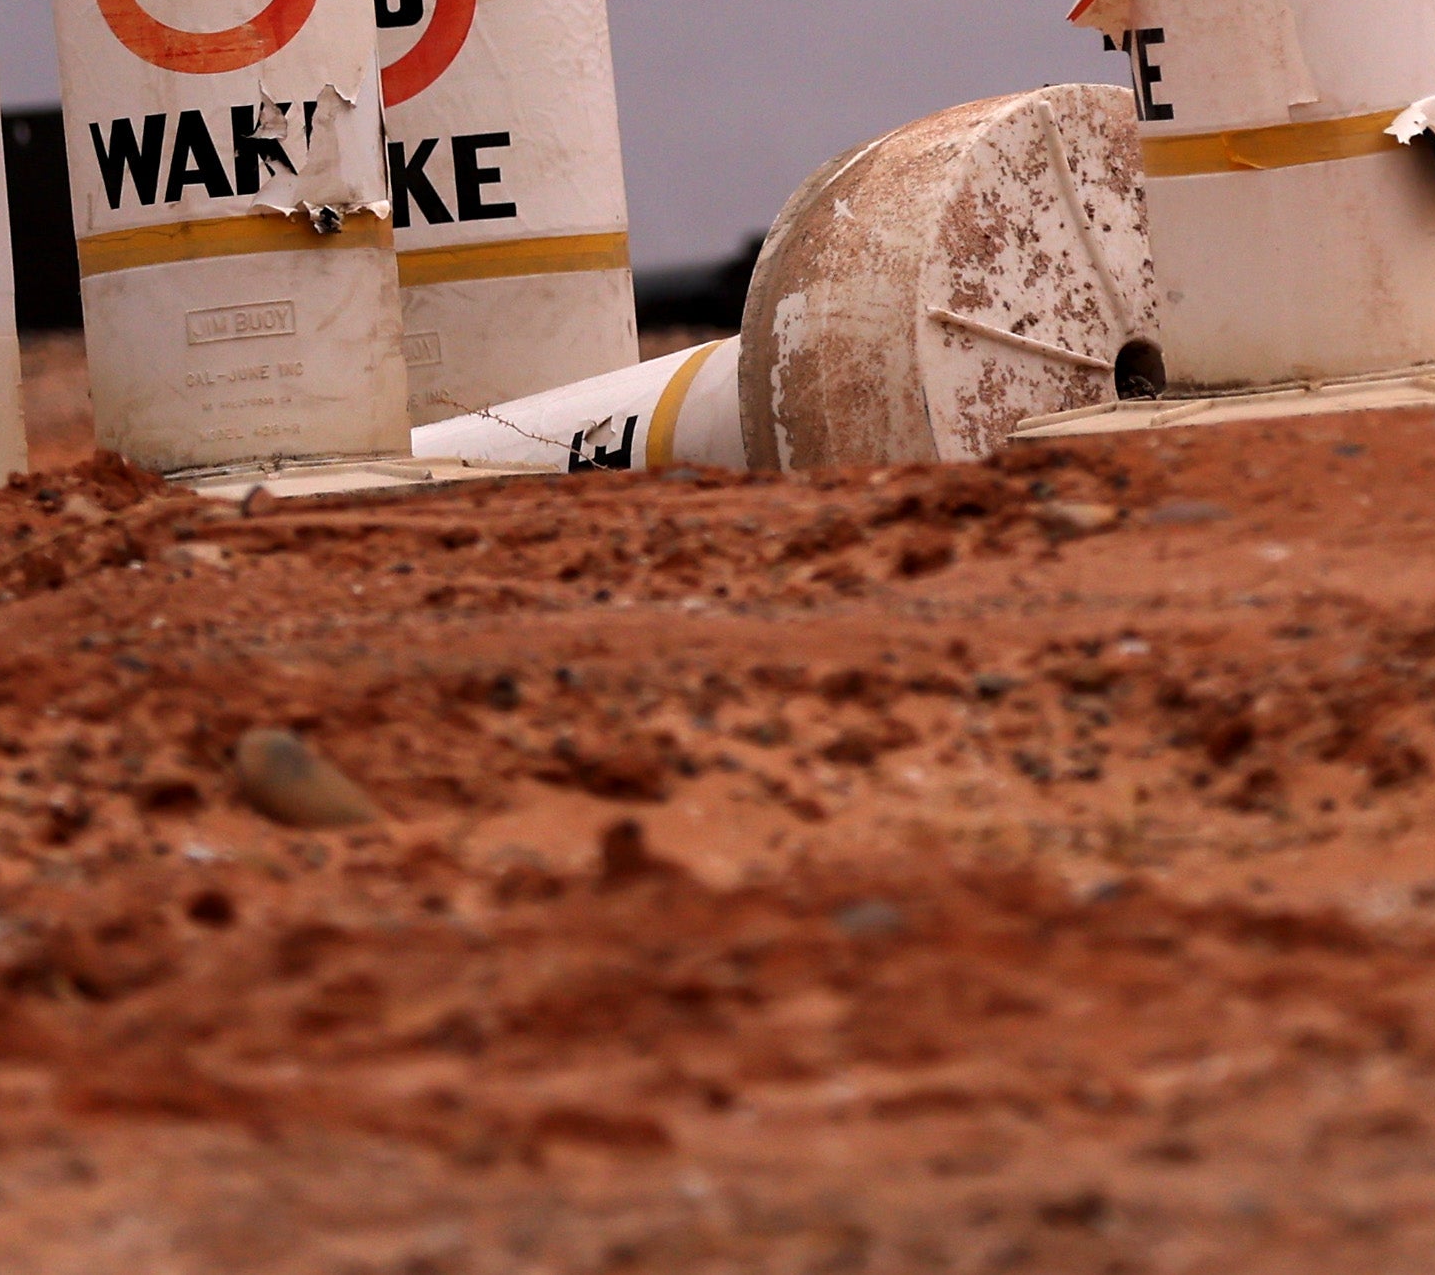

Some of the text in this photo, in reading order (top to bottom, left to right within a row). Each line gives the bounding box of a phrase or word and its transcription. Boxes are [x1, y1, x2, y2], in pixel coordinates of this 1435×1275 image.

[88, 100, 317, 210] WAK
[235, 306, 289, 333] BUOY
[185, 360, 304, 388] CAL-JUNE INC
